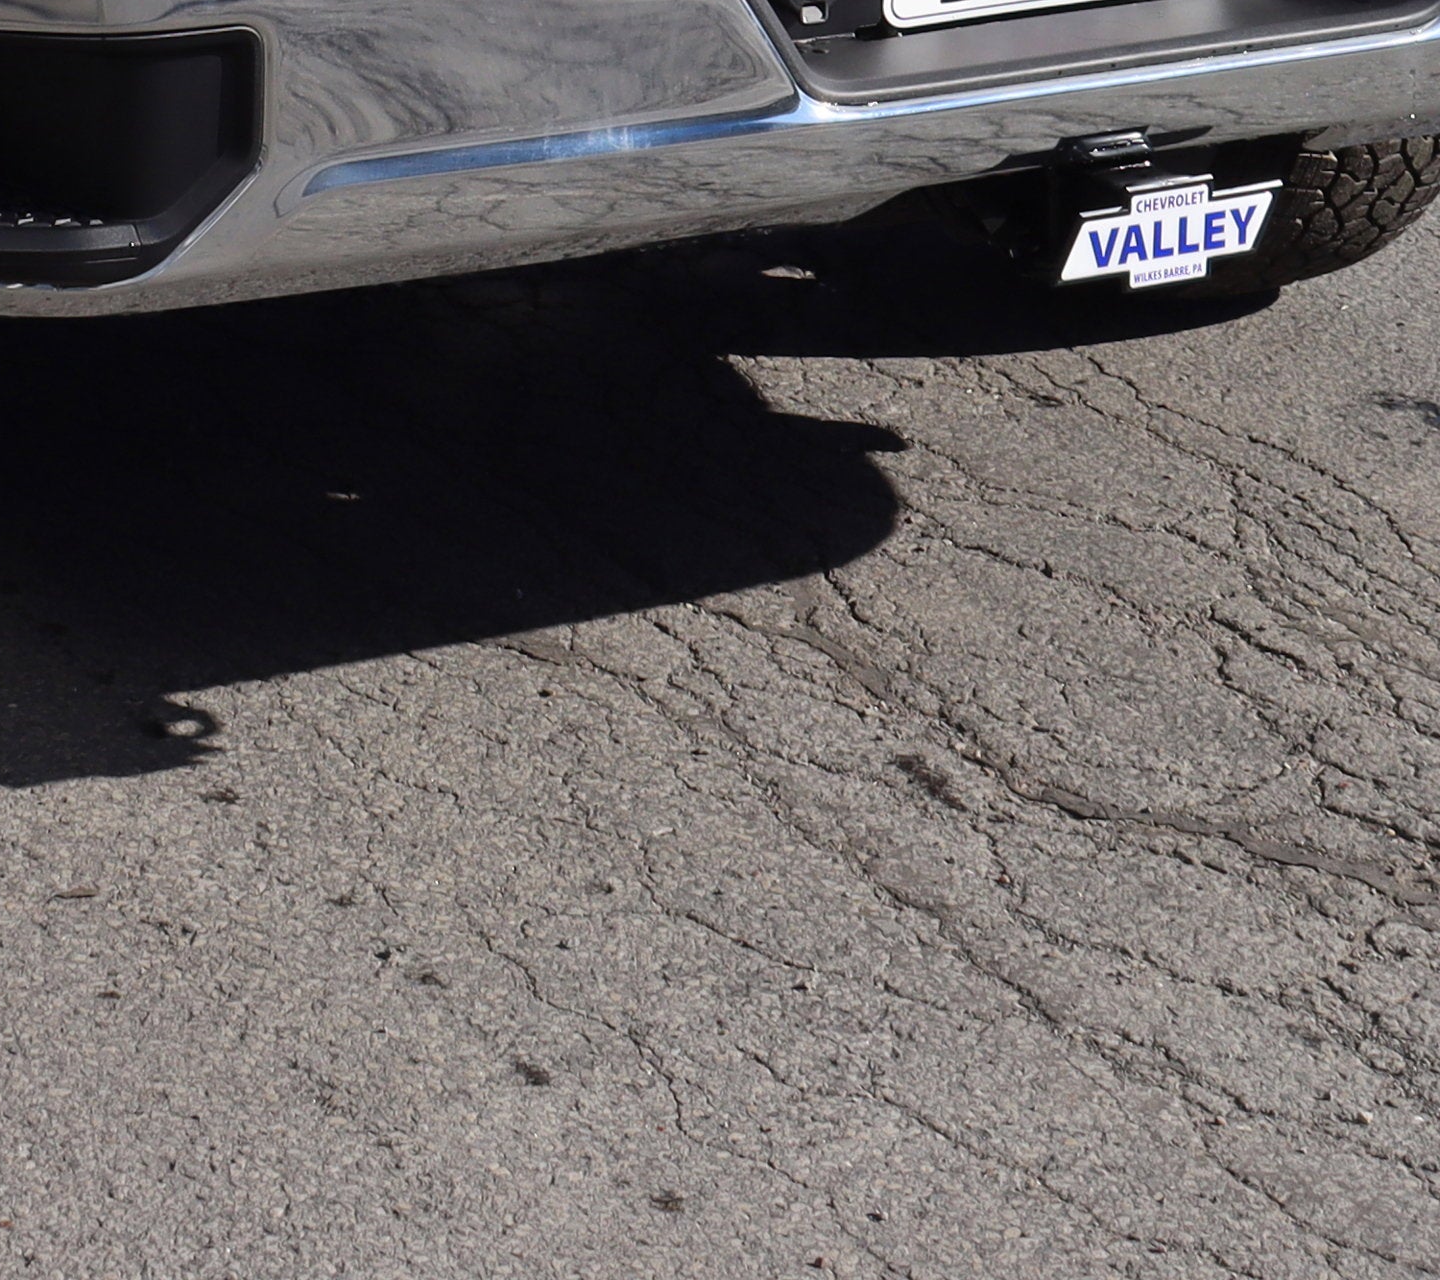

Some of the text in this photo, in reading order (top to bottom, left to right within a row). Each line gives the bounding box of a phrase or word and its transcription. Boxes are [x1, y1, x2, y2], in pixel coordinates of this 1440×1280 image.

[1135, 191, 1205, 214] CHEVROLET
[1088, 205, 1258, 269] VALLEY
[1133, 269, 1163, 284] WILKES
[1192, 263, 1203, 274] PA
